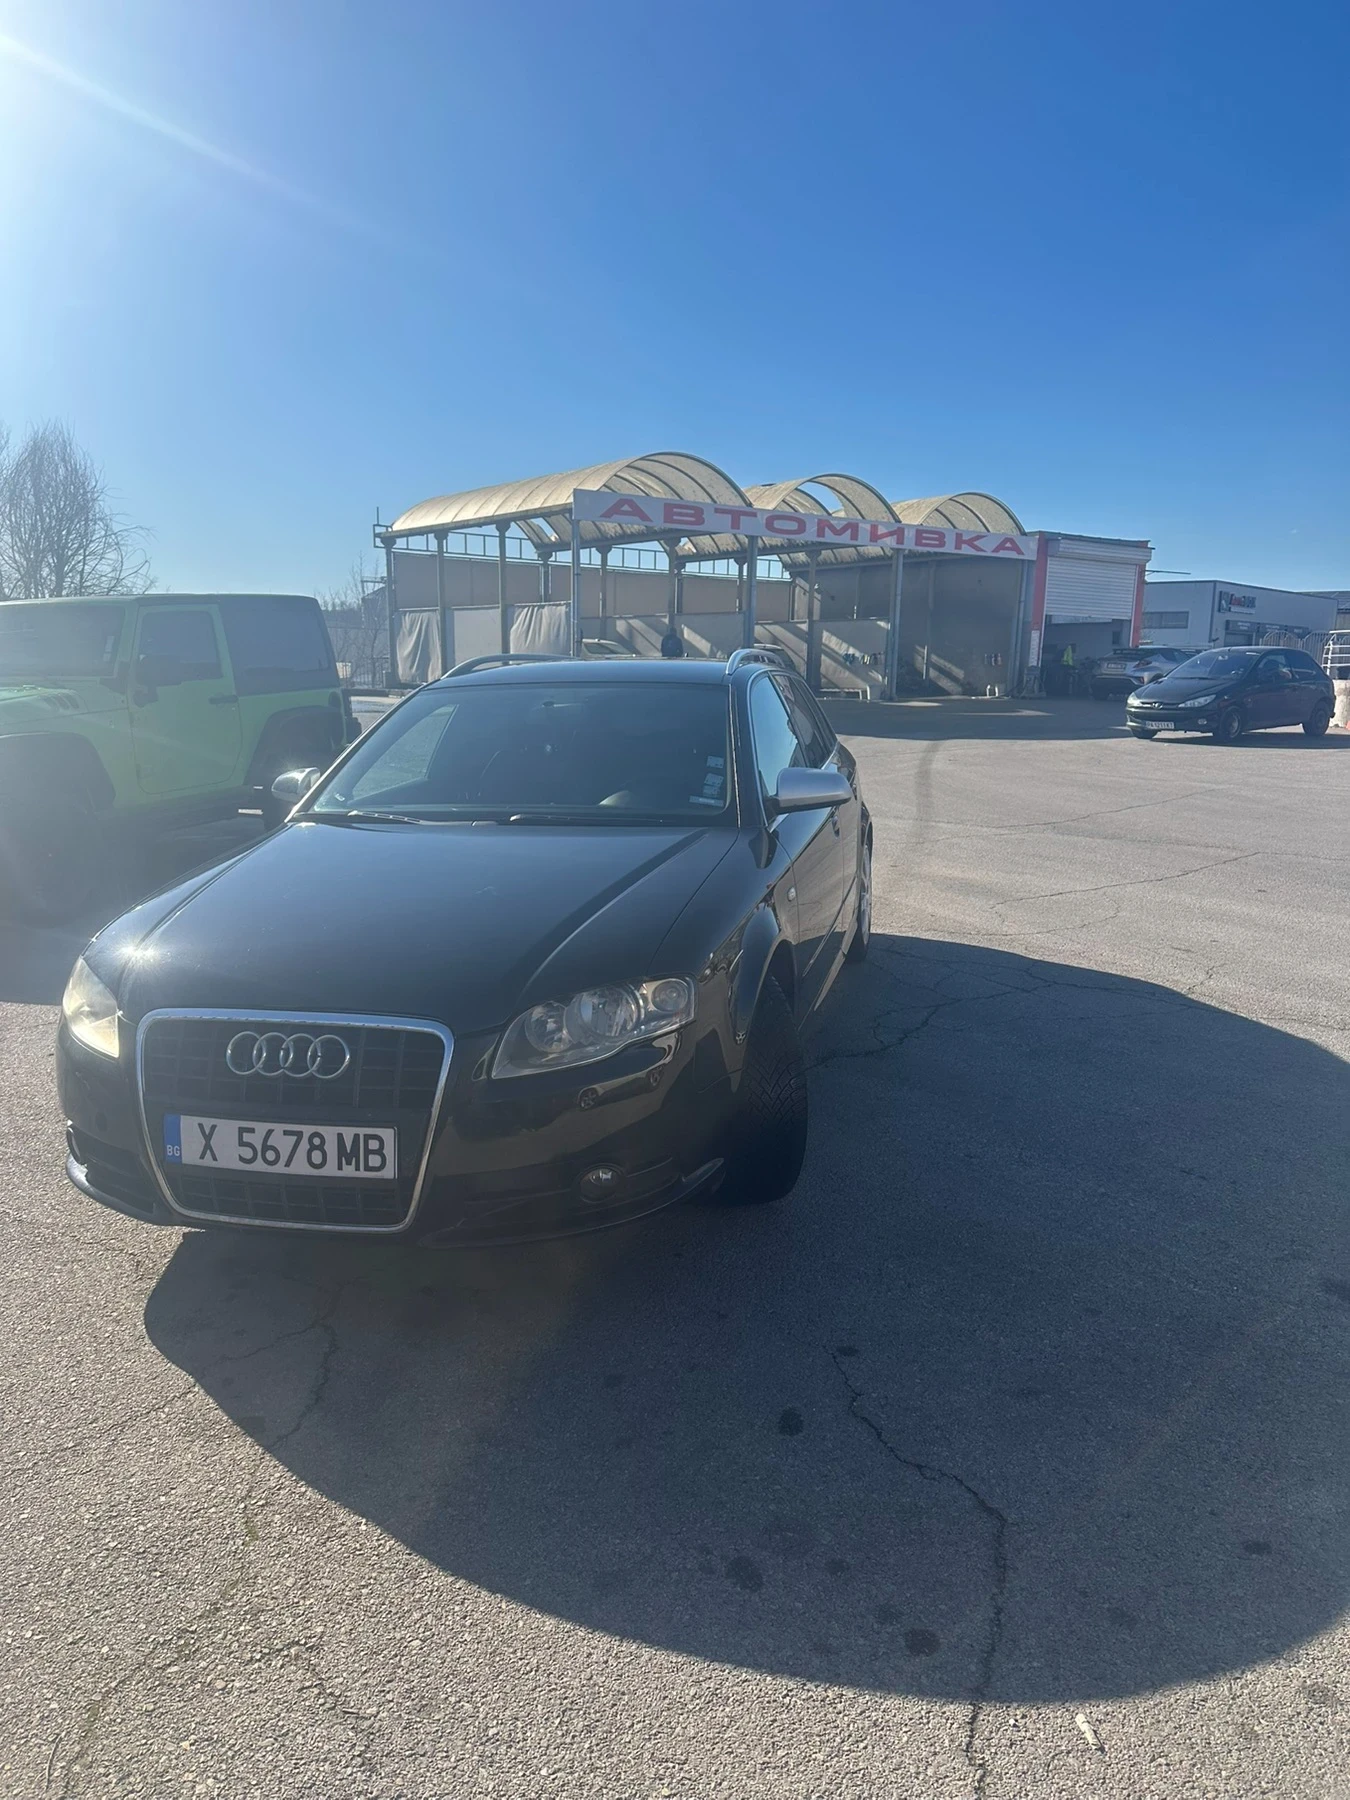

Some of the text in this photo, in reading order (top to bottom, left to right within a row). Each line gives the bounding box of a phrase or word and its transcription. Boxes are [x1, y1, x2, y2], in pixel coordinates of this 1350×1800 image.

[601, 499, 1025, 555] АВТОМИВКА
[166, 1144, 180, 1156] BG
[237, 1126, 328, 1169] 5678
